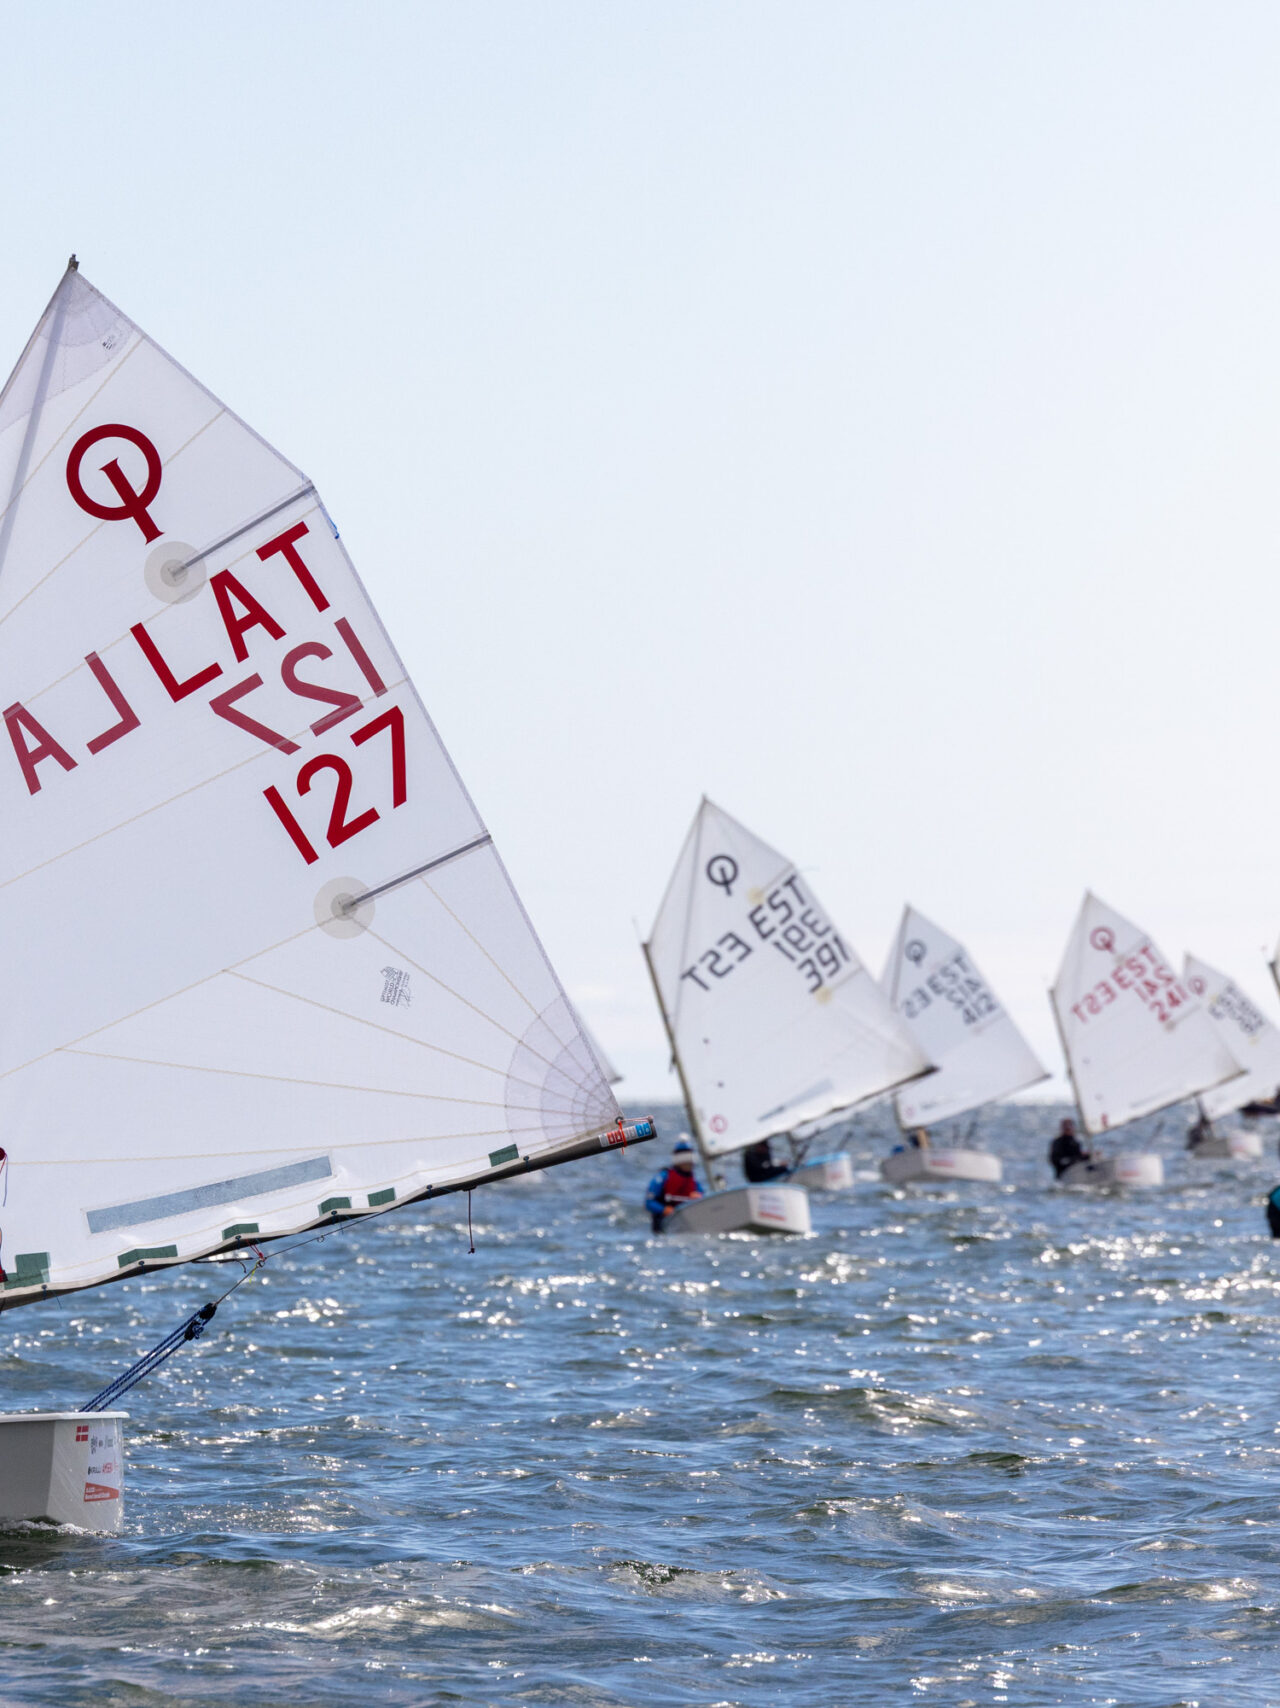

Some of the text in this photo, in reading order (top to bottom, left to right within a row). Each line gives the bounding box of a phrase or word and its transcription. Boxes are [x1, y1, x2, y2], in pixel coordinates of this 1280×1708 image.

[130, 521, 330, 704] LAT
[263, 705, 408, 866] 127
[748, 874, 805, 940] EST
[798, 935, 850, 994] 391
[1111, 944, 1157, 990] EST
